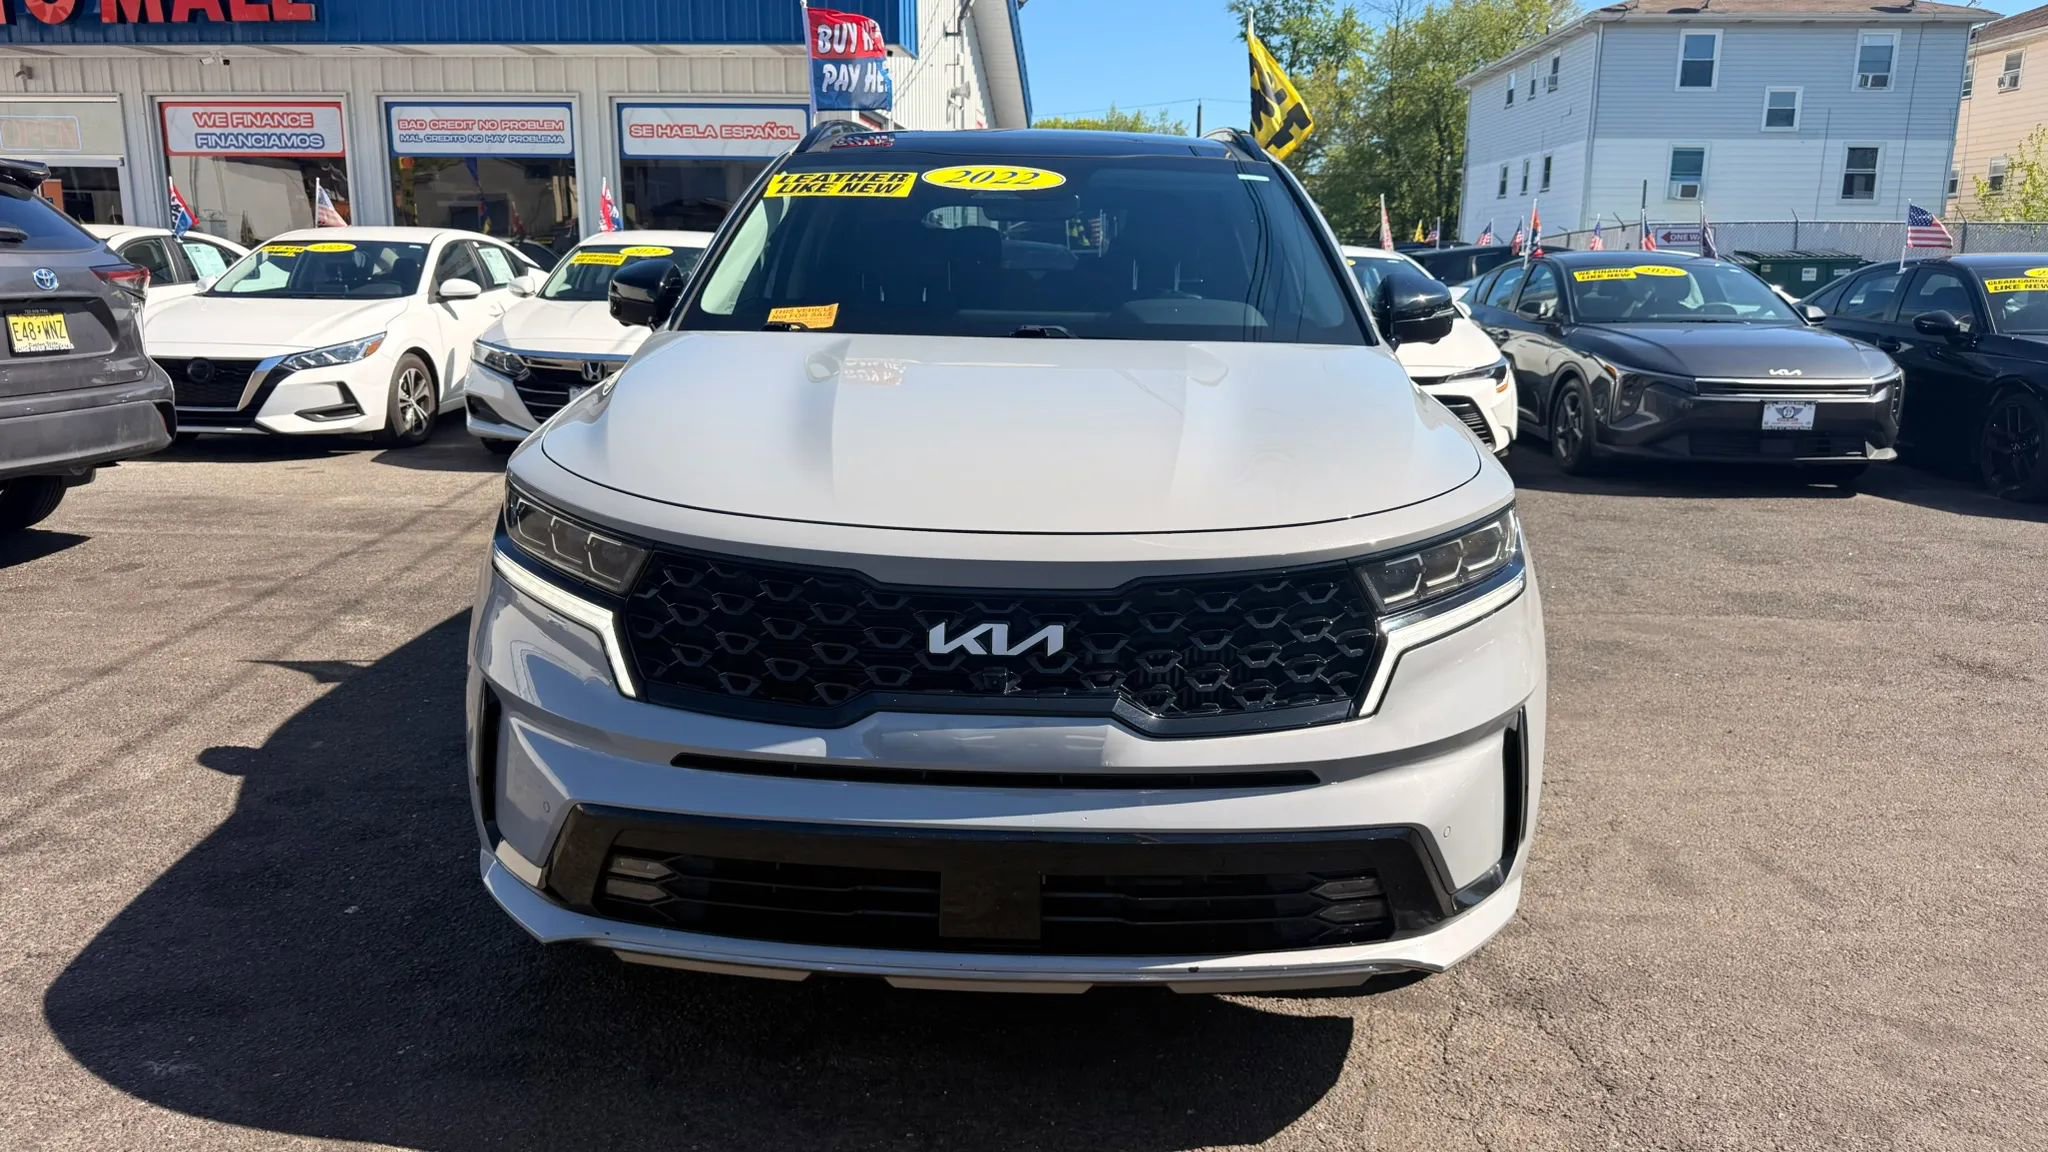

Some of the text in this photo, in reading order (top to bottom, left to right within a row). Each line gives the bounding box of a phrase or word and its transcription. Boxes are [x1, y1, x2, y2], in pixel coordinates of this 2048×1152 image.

[817, 23, 858, 54] BUY
[822, 63, 861, 93] PAY
[193, 112, 314, 128] WE FINANCE
[398, 119, 564, 131] BAD CREDIT NO PROBLEM
[630, 121, 801, 140] SE HABLA ESPAÑOL
[195, 133, 325, 149] FINANCIAMOS
[399, 134, 565, 144] MAL CREDITO NO HAY PROBLEMA
[777, 173, 910, 183] LEATHER
[943, 170, 1041, 185] 2022
[776, 183, 903, 194] LIKE NEW
[1670, 233, 1689, 241] ONE
[12, 320, 67, 342] E48 WNZ
[928, 621, 1065, 657] KIA
